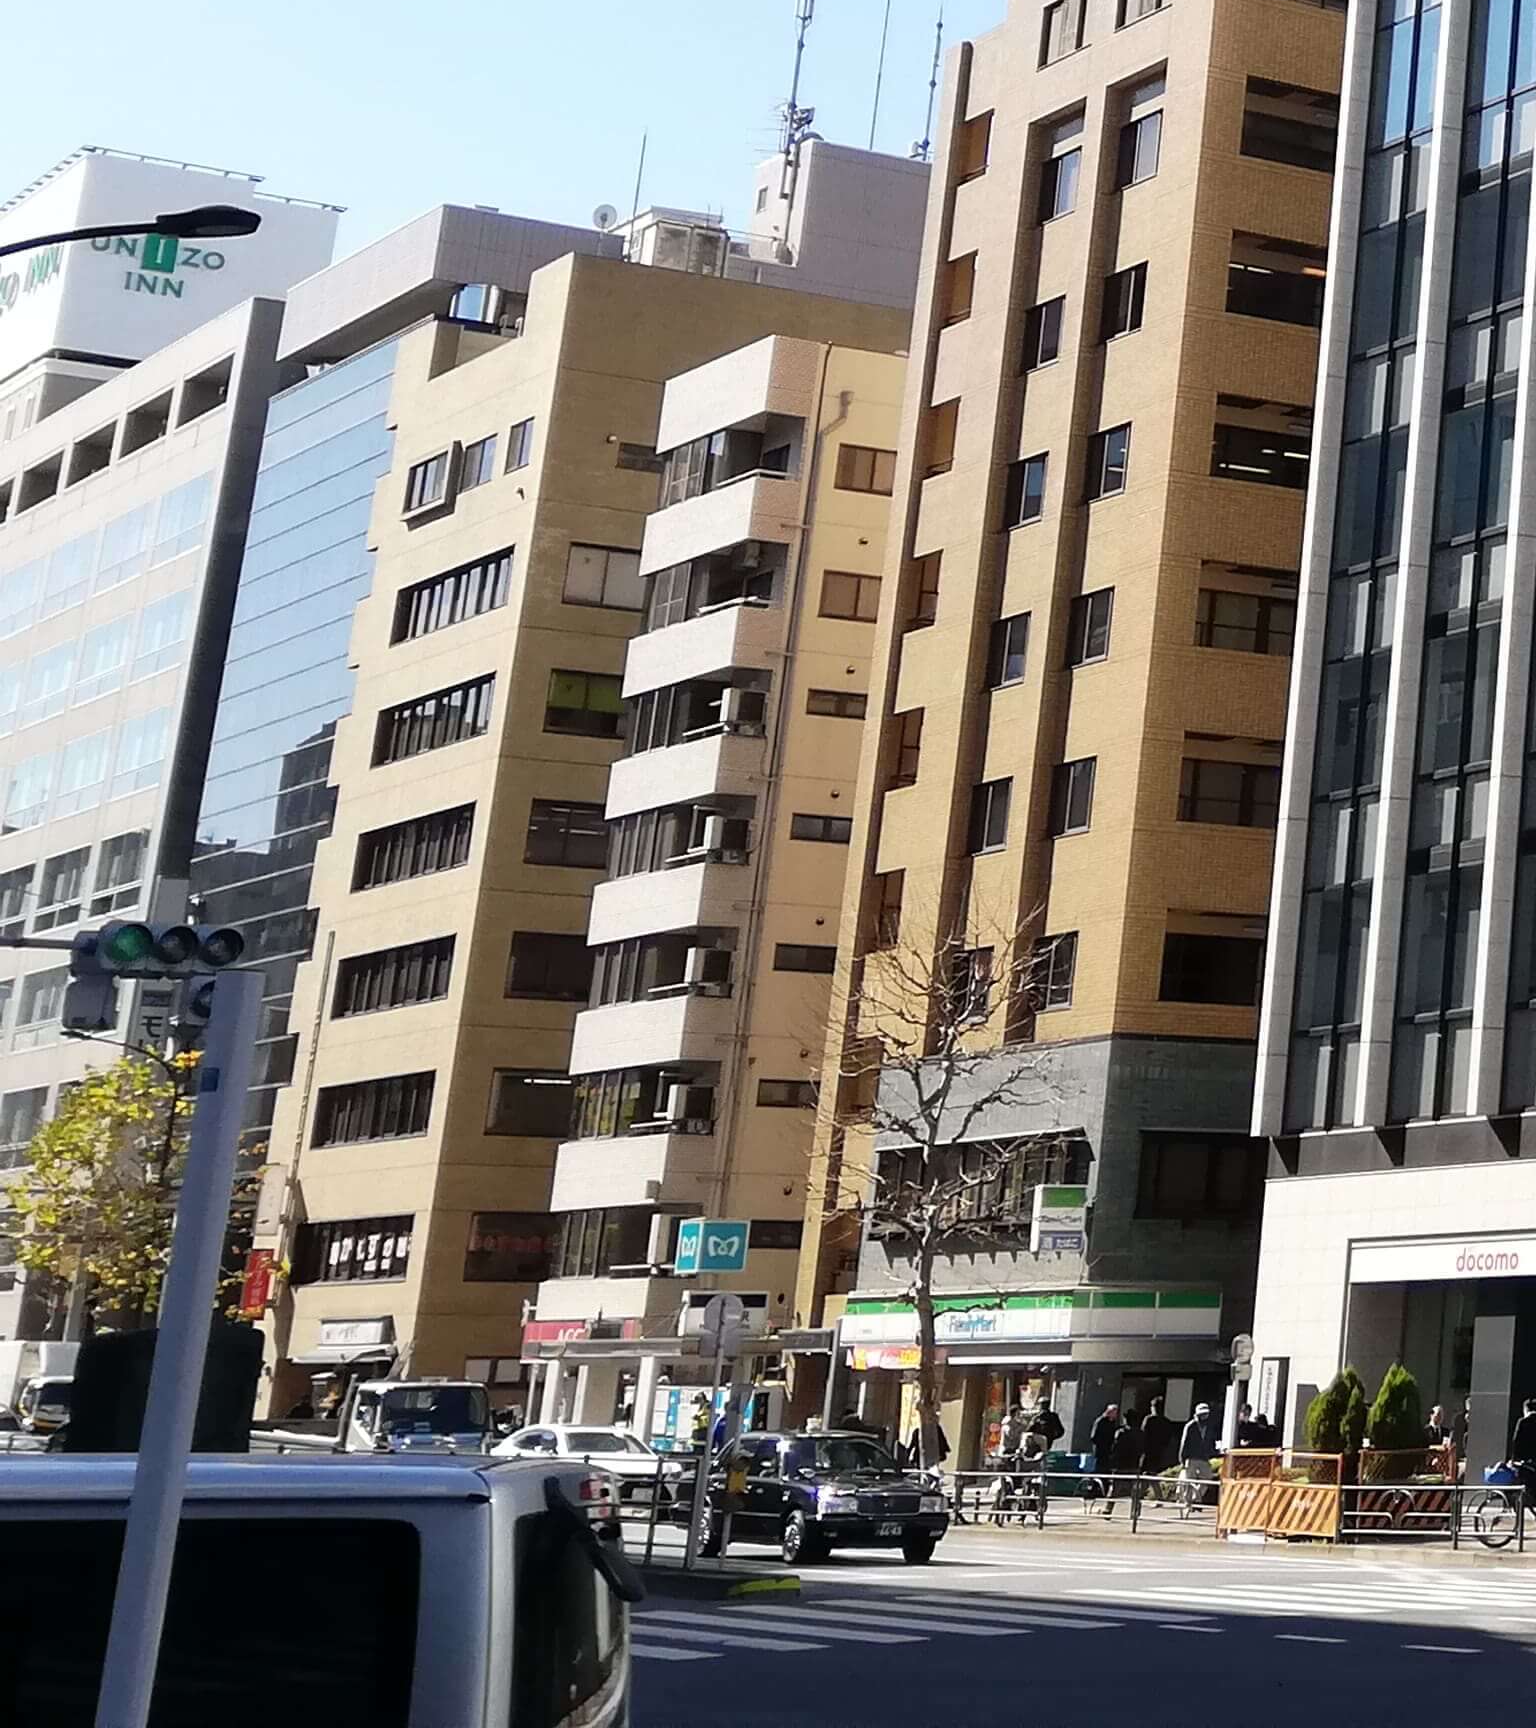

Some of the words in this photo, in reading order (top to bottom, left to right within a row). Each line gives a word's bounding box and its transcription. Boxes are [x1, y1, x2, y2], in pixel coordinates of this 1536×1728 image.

[91, 233, 226, 272] UNIZO
[123, 271, 185, 299] INN
[1456, 1248, 1519, 1272] docomo
